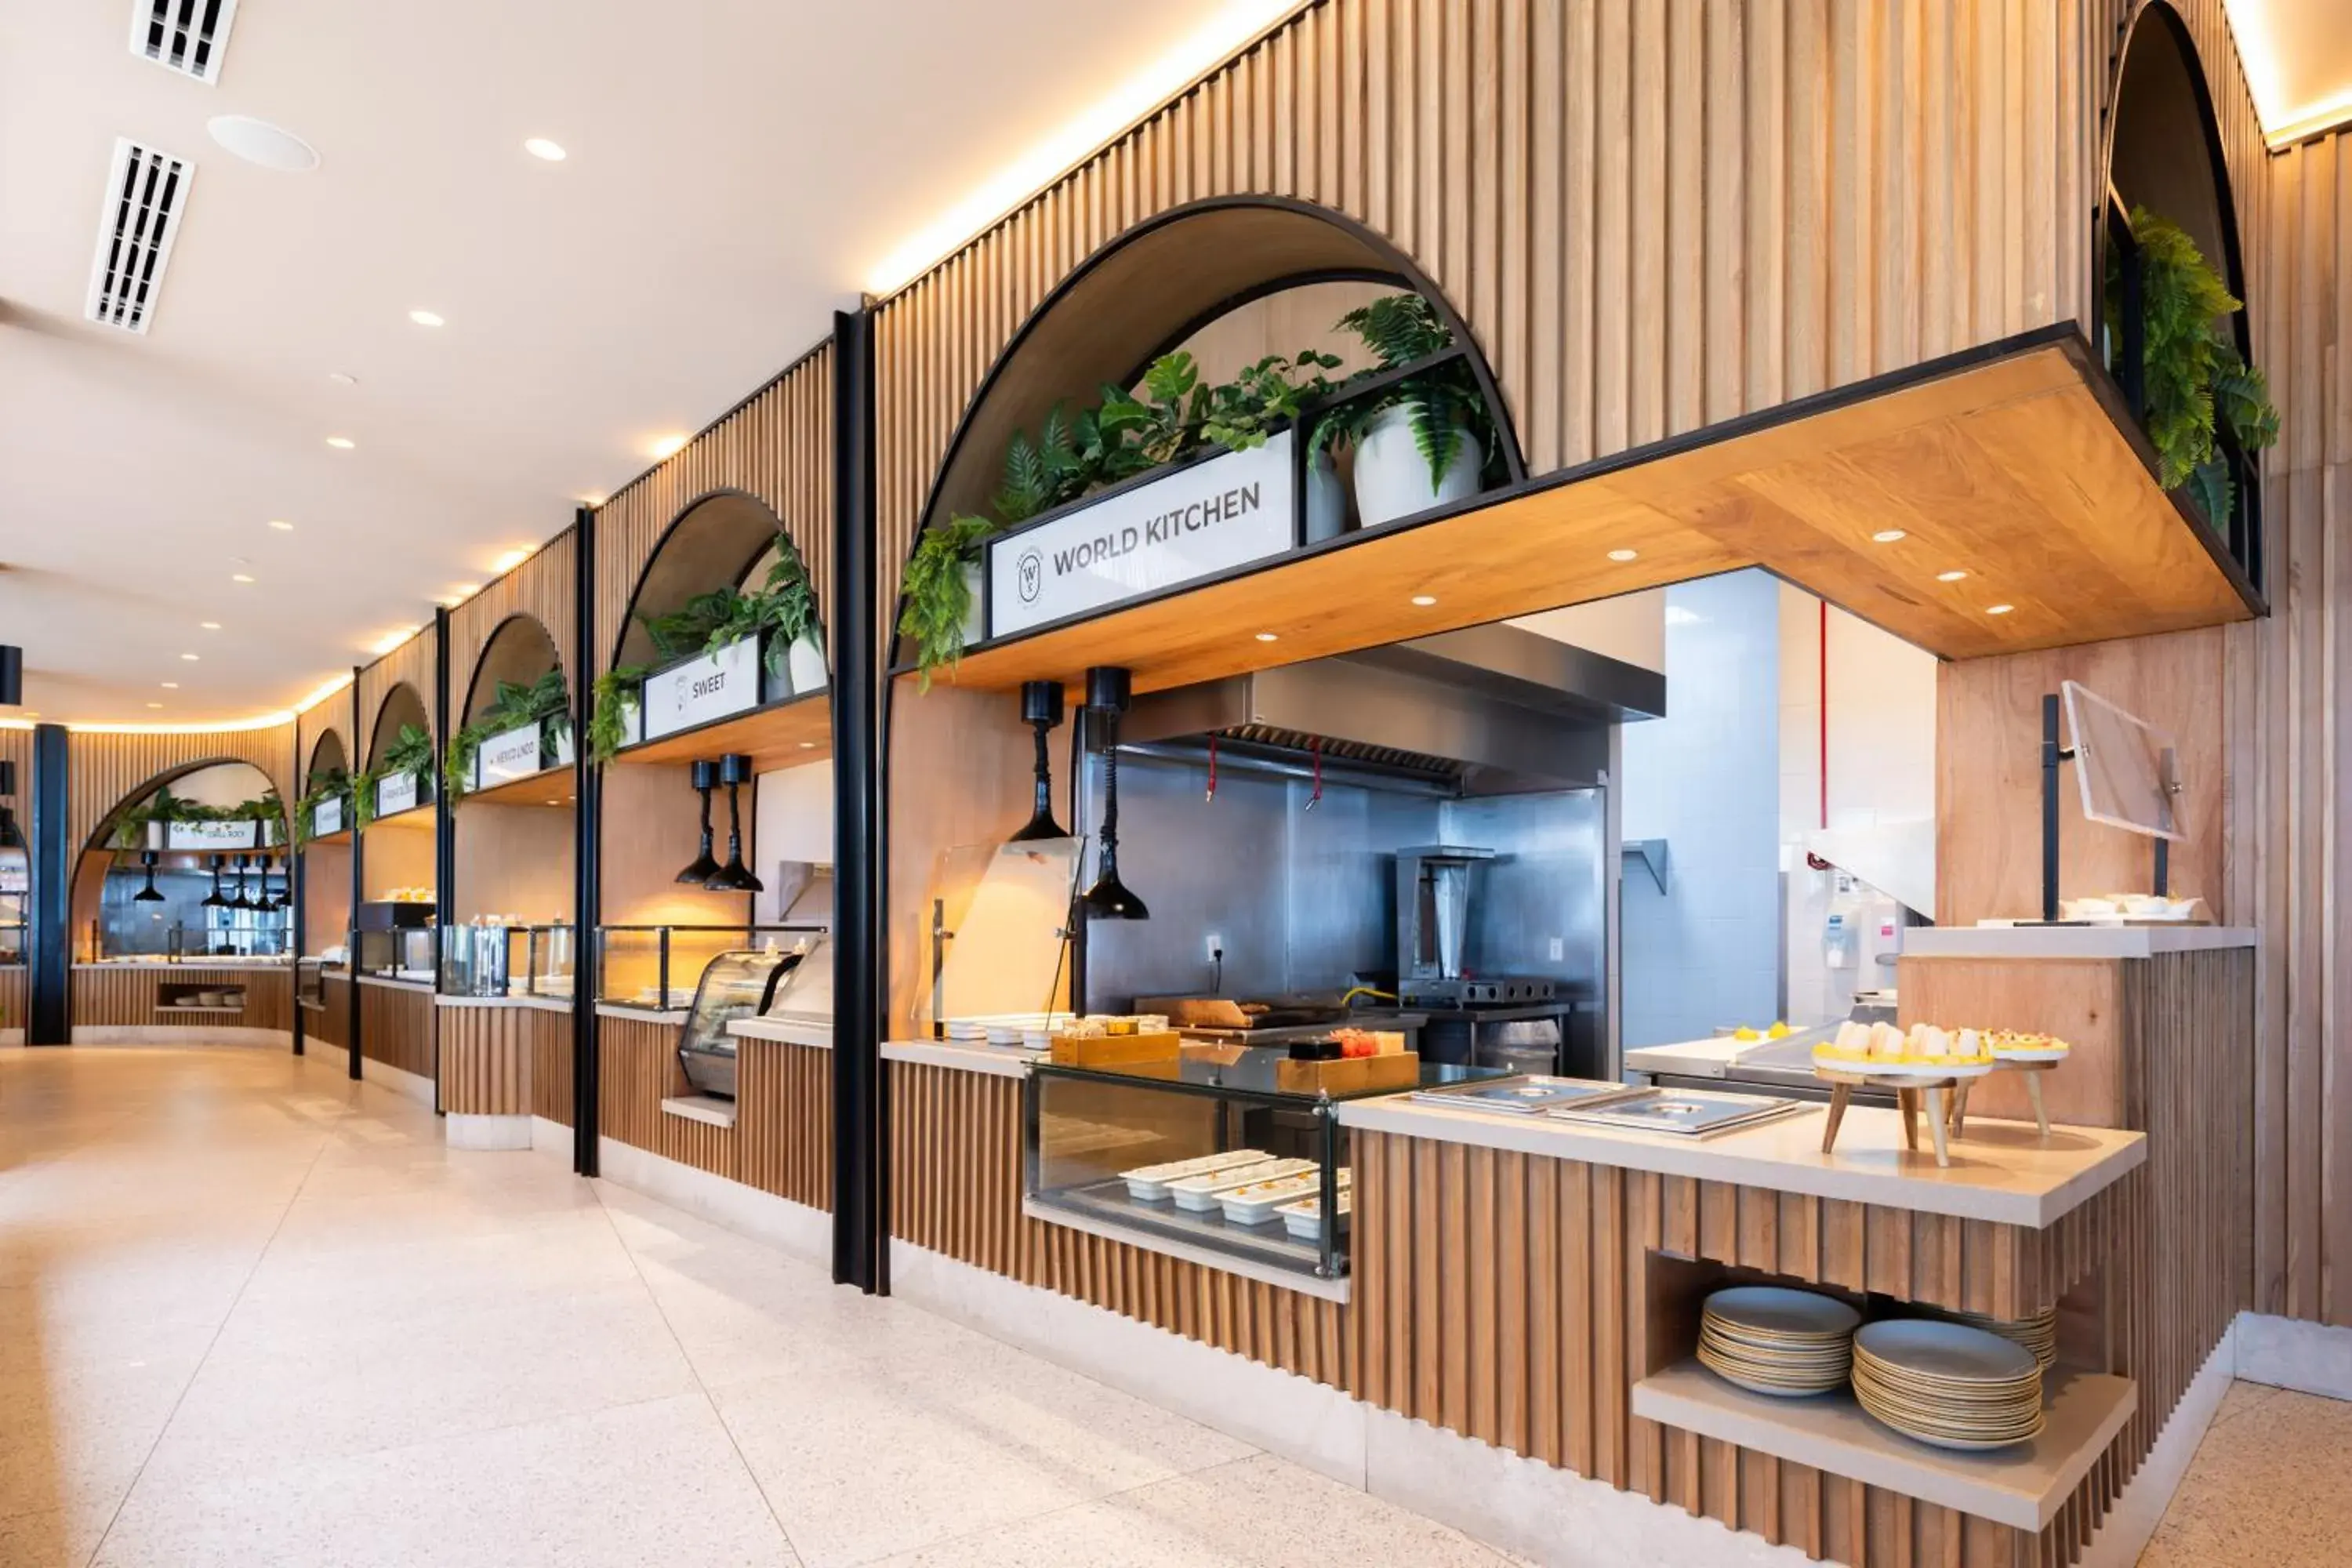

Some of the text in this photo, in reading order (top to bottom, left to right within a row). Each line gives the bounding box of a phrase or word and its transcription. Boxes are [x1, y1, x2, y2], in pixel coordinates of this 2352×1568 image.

[1053, 526, 1138, 576] WORLD
[1145, 481, 1260, 546] KITCHEN
[692, 672, 726, 699] SWEET
